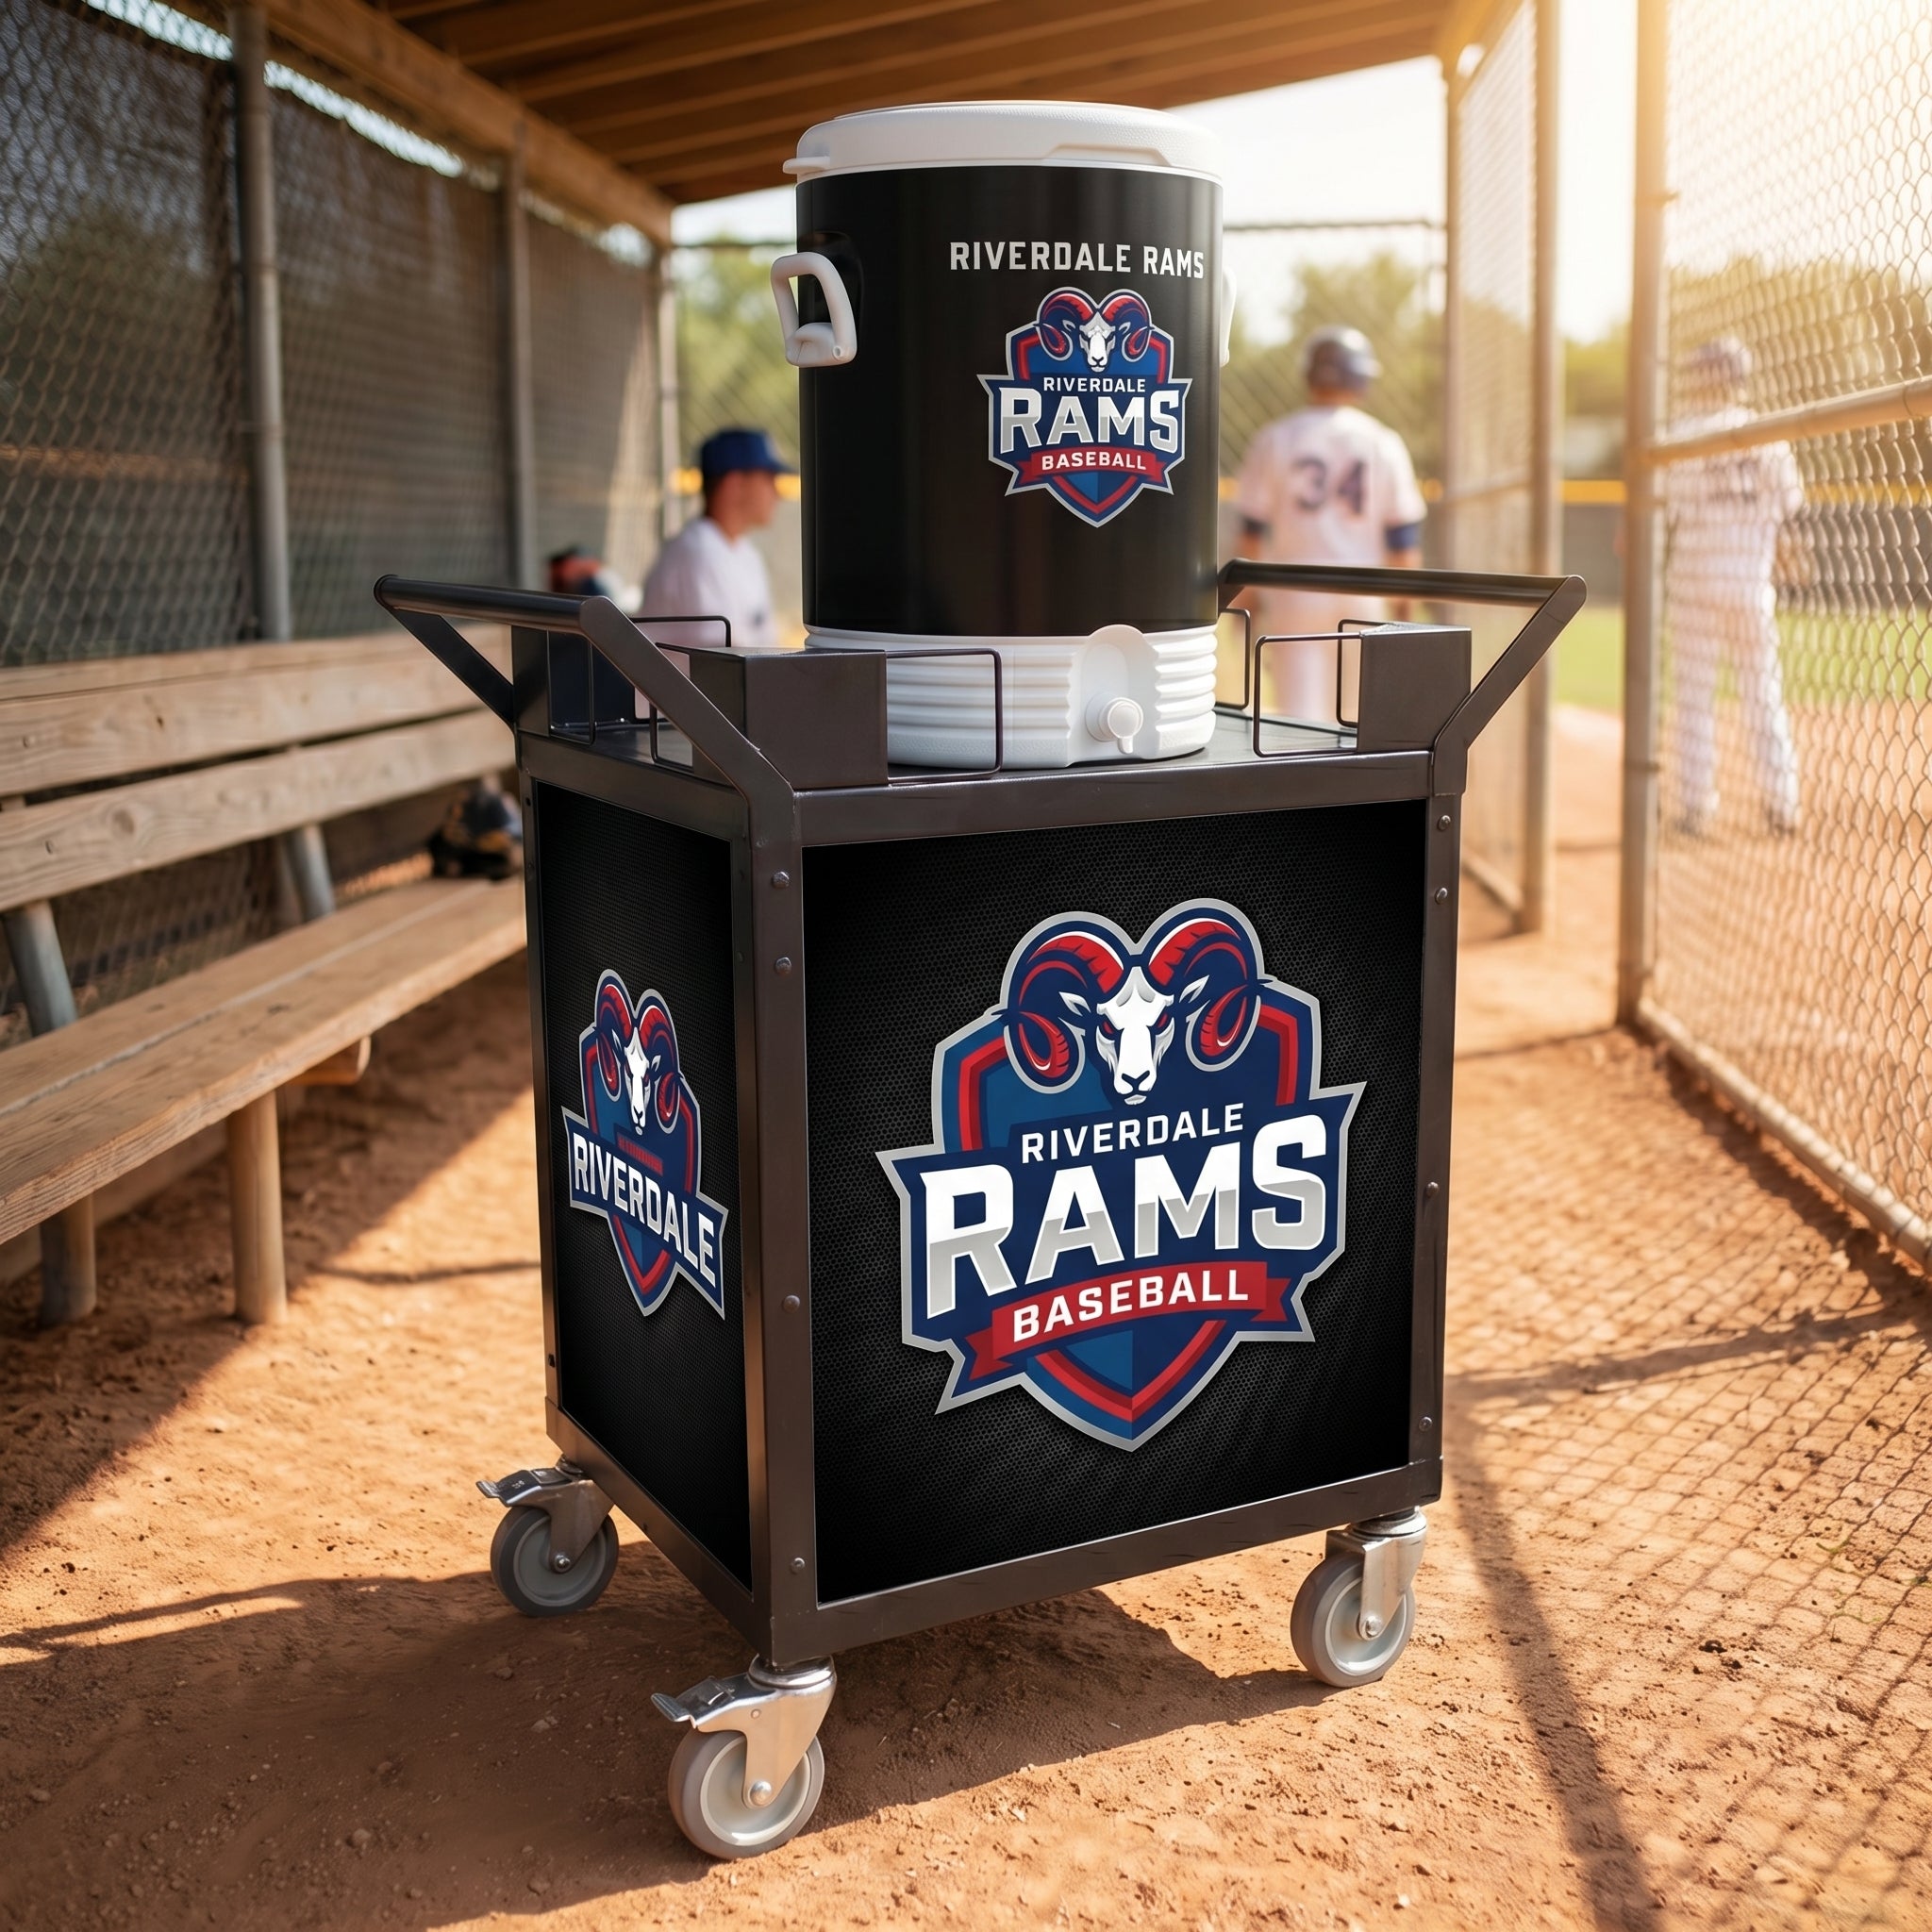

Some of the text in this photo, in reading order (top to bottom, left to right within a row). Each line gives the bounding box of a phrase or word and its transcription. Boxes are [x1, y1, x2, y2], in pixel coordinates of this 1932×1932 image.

[950, 242, 1204, 279] RIVERDALE RAMS
[1043, 376, 1146, 392] RIVERDALE
[998, 387, 1180, 455] RAMS
[1041, 451, 1147, 471] BASEBALL
[1292, 455, 1365, 515] 34
[1021, 1102, 1244, 1164] RIVERDALE
[573, 1132, 716, 1289] RIVERDALE
[919, 1114, 1327, 1320] RAMS
[1012, 1269, 1249, 1343] BASEBALL
